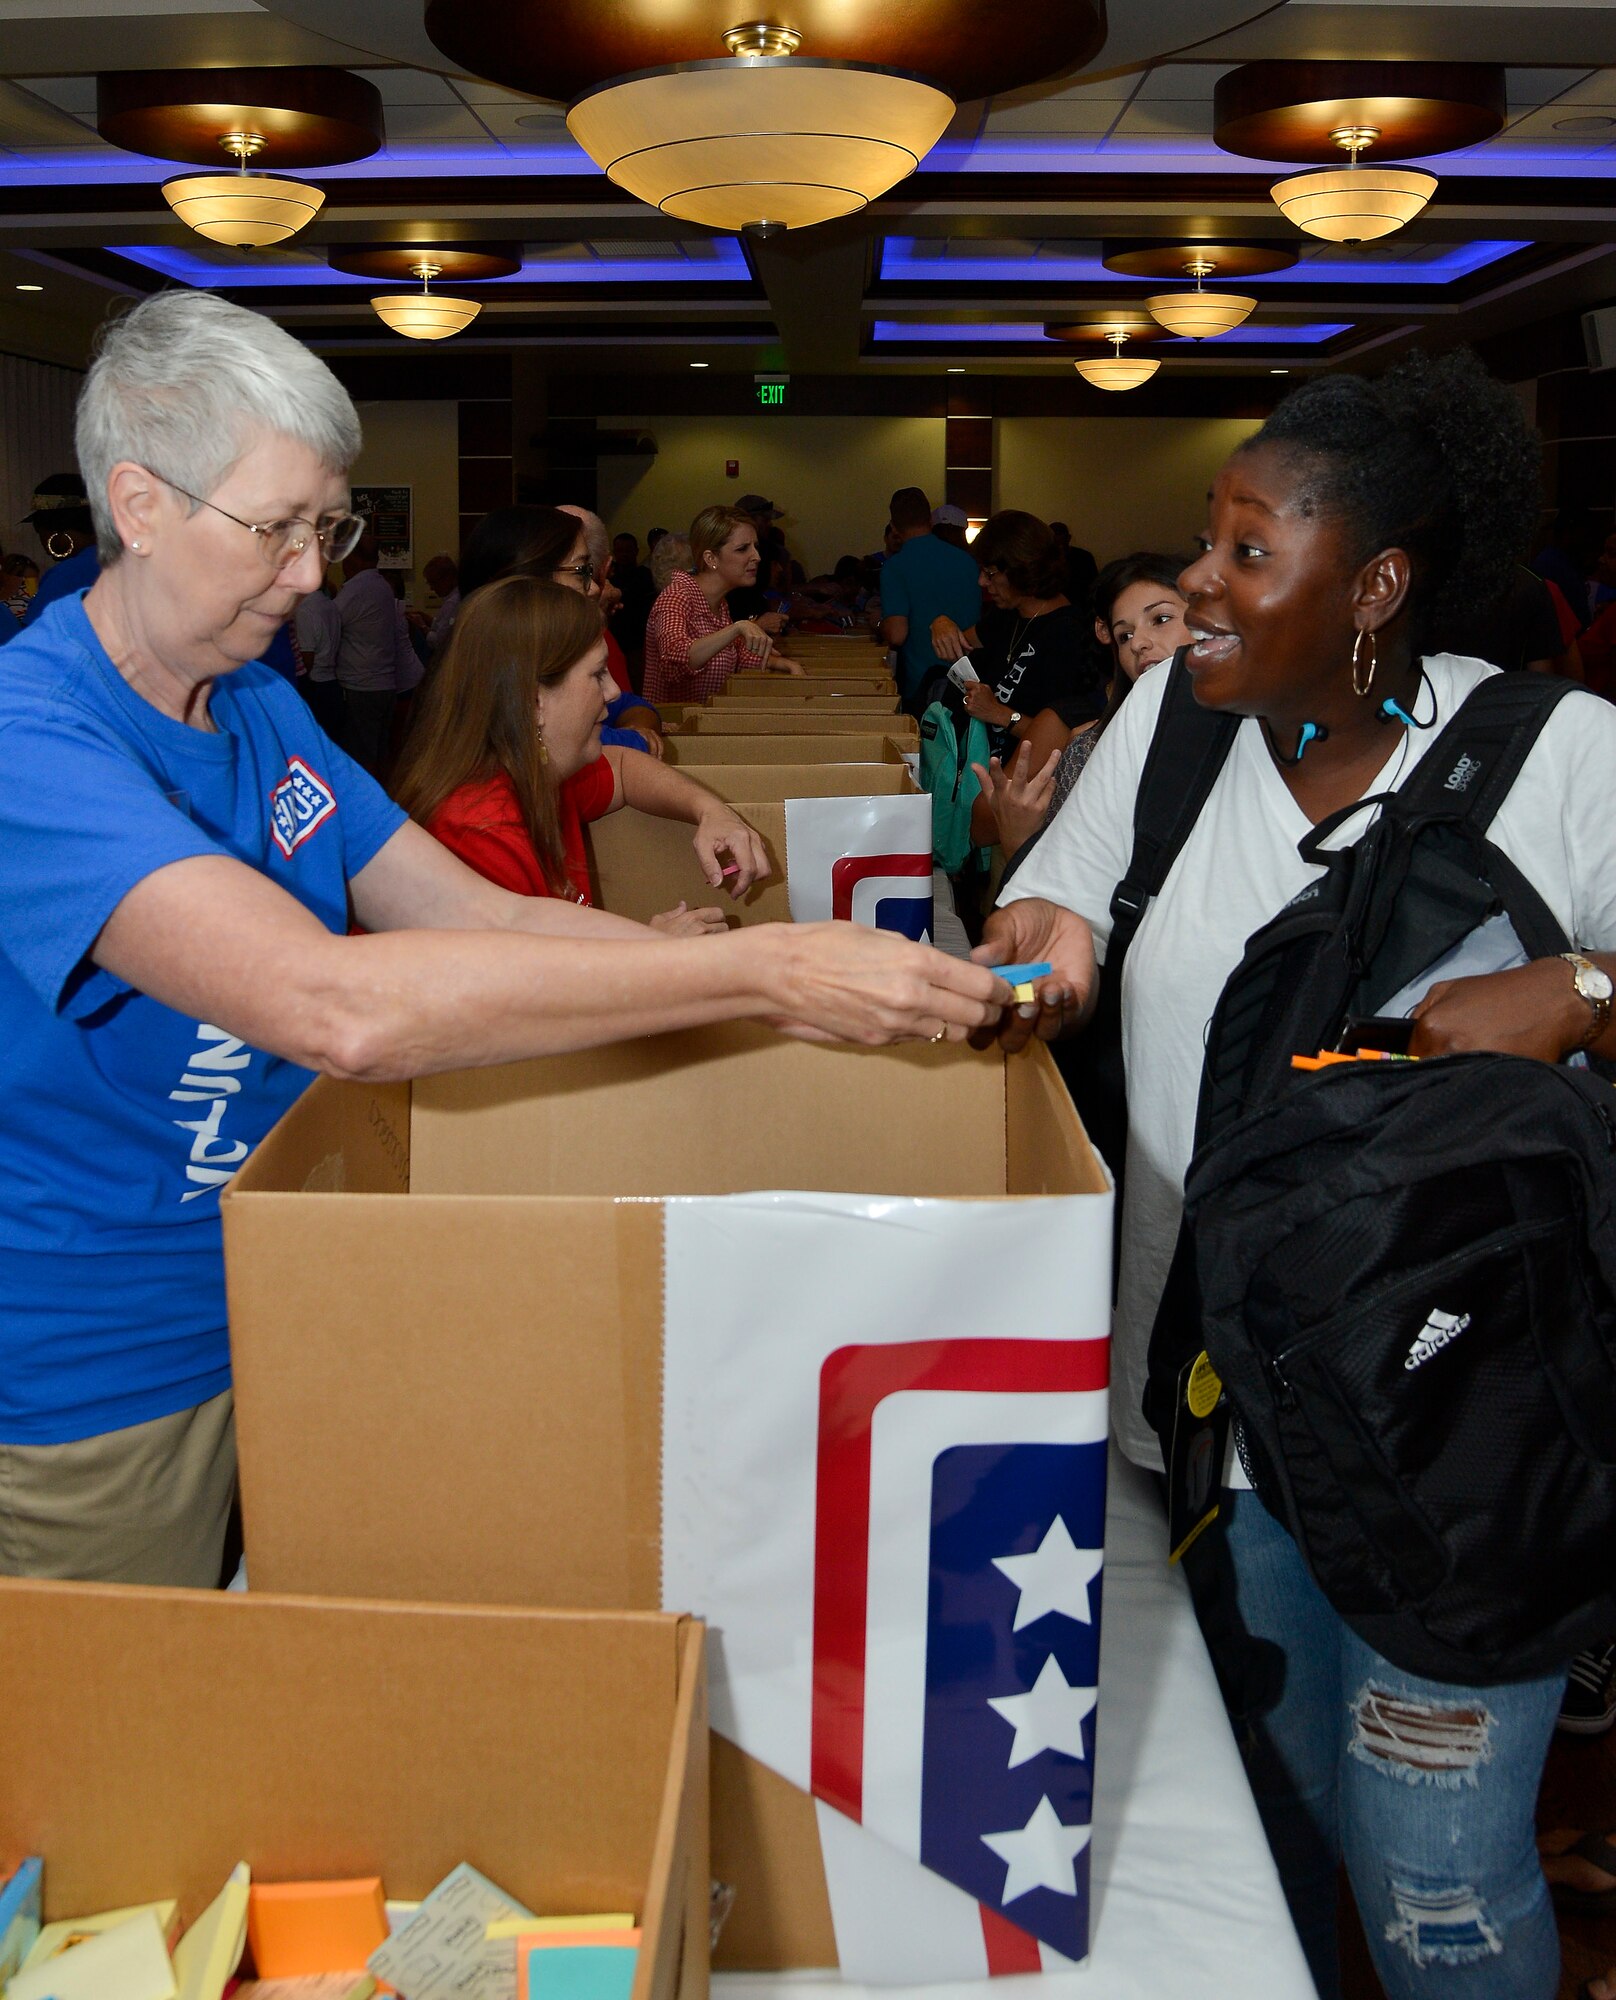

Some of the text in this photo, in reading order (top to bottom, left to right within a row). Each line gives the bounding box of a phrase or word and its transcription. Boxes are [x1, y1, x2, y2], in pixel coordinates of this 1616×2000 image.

[761, 385, 785, 404] EXIT
[1443, 757, 1471, 790] LOAD
[1404, 1312, 1471, 1371] adidas
